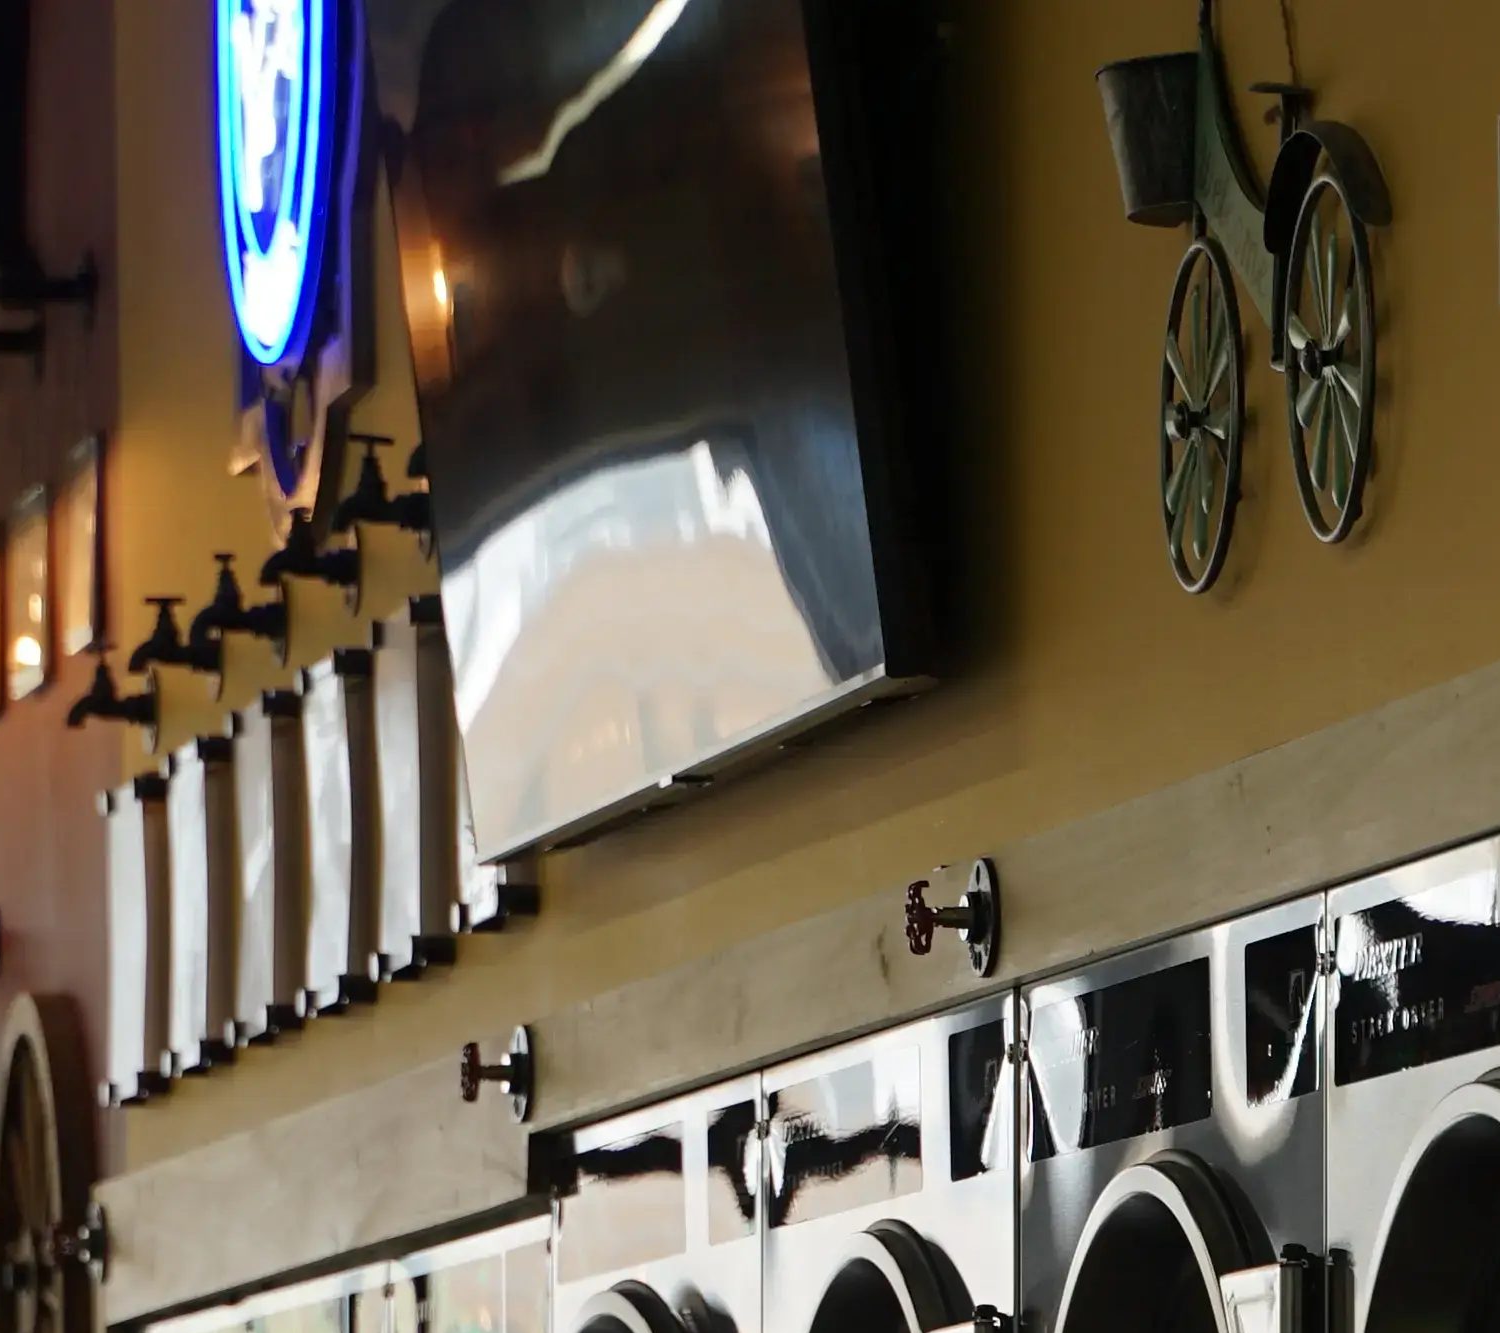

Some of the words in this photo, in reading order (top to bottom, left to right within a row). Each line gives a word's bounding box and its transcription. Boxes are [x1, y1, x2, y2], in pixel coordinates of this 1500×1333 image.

[1353, 932, 1423, 983] DEXTER
[1351, 1008, 1394, 1045] STACK
[1401, 996, 1444, 1031] DRYER
